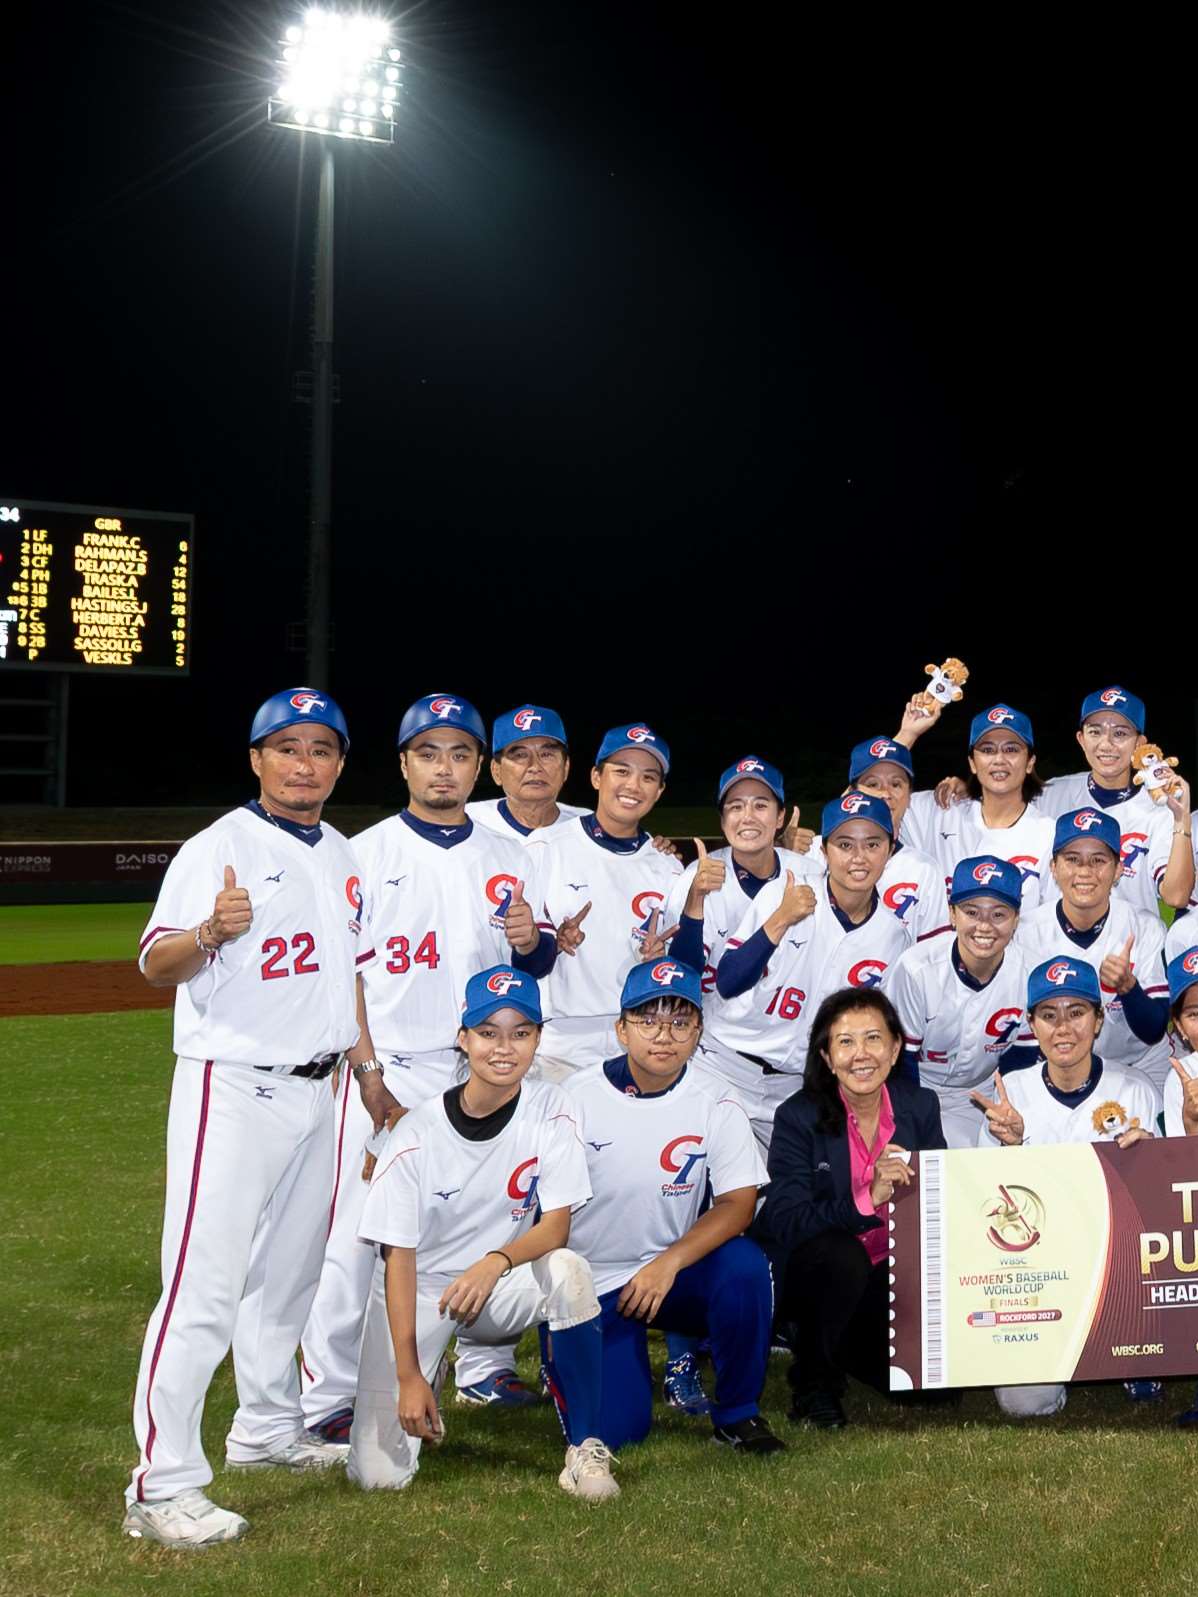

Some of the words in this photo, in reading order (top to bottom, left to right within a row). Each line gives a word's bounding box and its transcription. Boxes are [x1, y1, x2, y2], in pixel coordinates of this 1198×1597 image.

[95, 518, 121, 531] GBR
[22, 529, 30, 540] 1
[32, 529, 48, 542] LF
[83, 533, 140, 549] FRANK.C
[21, 542, 30, 554] 2
[32, 543, 53, 555] DH
[179, 554, 187, 564] 4
[21, 555, 30, 567] 3
[31, 556, 48, 568] CF
[173, 567, 187, 578] 12
[20, 569, 29, 579] 4
[83, 572, 138, 587] TRASK.A
[171, 579, 186, 590] 54
[20, 582, 29, 593] 5
[31, 583, 48, 594] 1B
[31, 596, 47, 607] 3B
[71, 598, 148, 614] HASTINGS.J
[19, 609, 28, 620] 7
[29, 609, 40, 621] C
[29, 622, 46, 634] SS
[28, 649, 38, 660] P
[176, 643, 184, 654] 2
[4, 856, 51, 865] NIPPON
[115, 853, 169, 864] DAISO
[261, 932, 320, 981] 22
[385, 931, 441, 975] 34
[765, 985, 806, 1020] 16
[1000, 1257, 1028, 1266] WBSC
[959, 1272, 1014, 1287] WOMEN'S
[1015, 1270, 1070, 1284] BASEBALL
[983, 1285, 1022, 1296] WORLD
[1023, 1282, 1044, 1294] CUP
[999, 1298, 1029, 1307] FINALS
[999, 1313, 1037, 1323] ROCKFORD
[1037, 1311, 1056, 1321] 2027
[1004, 1333, 1040, 1343] RAXUS
[1111, 1343, 1164, 1357] WBSC.ORG
